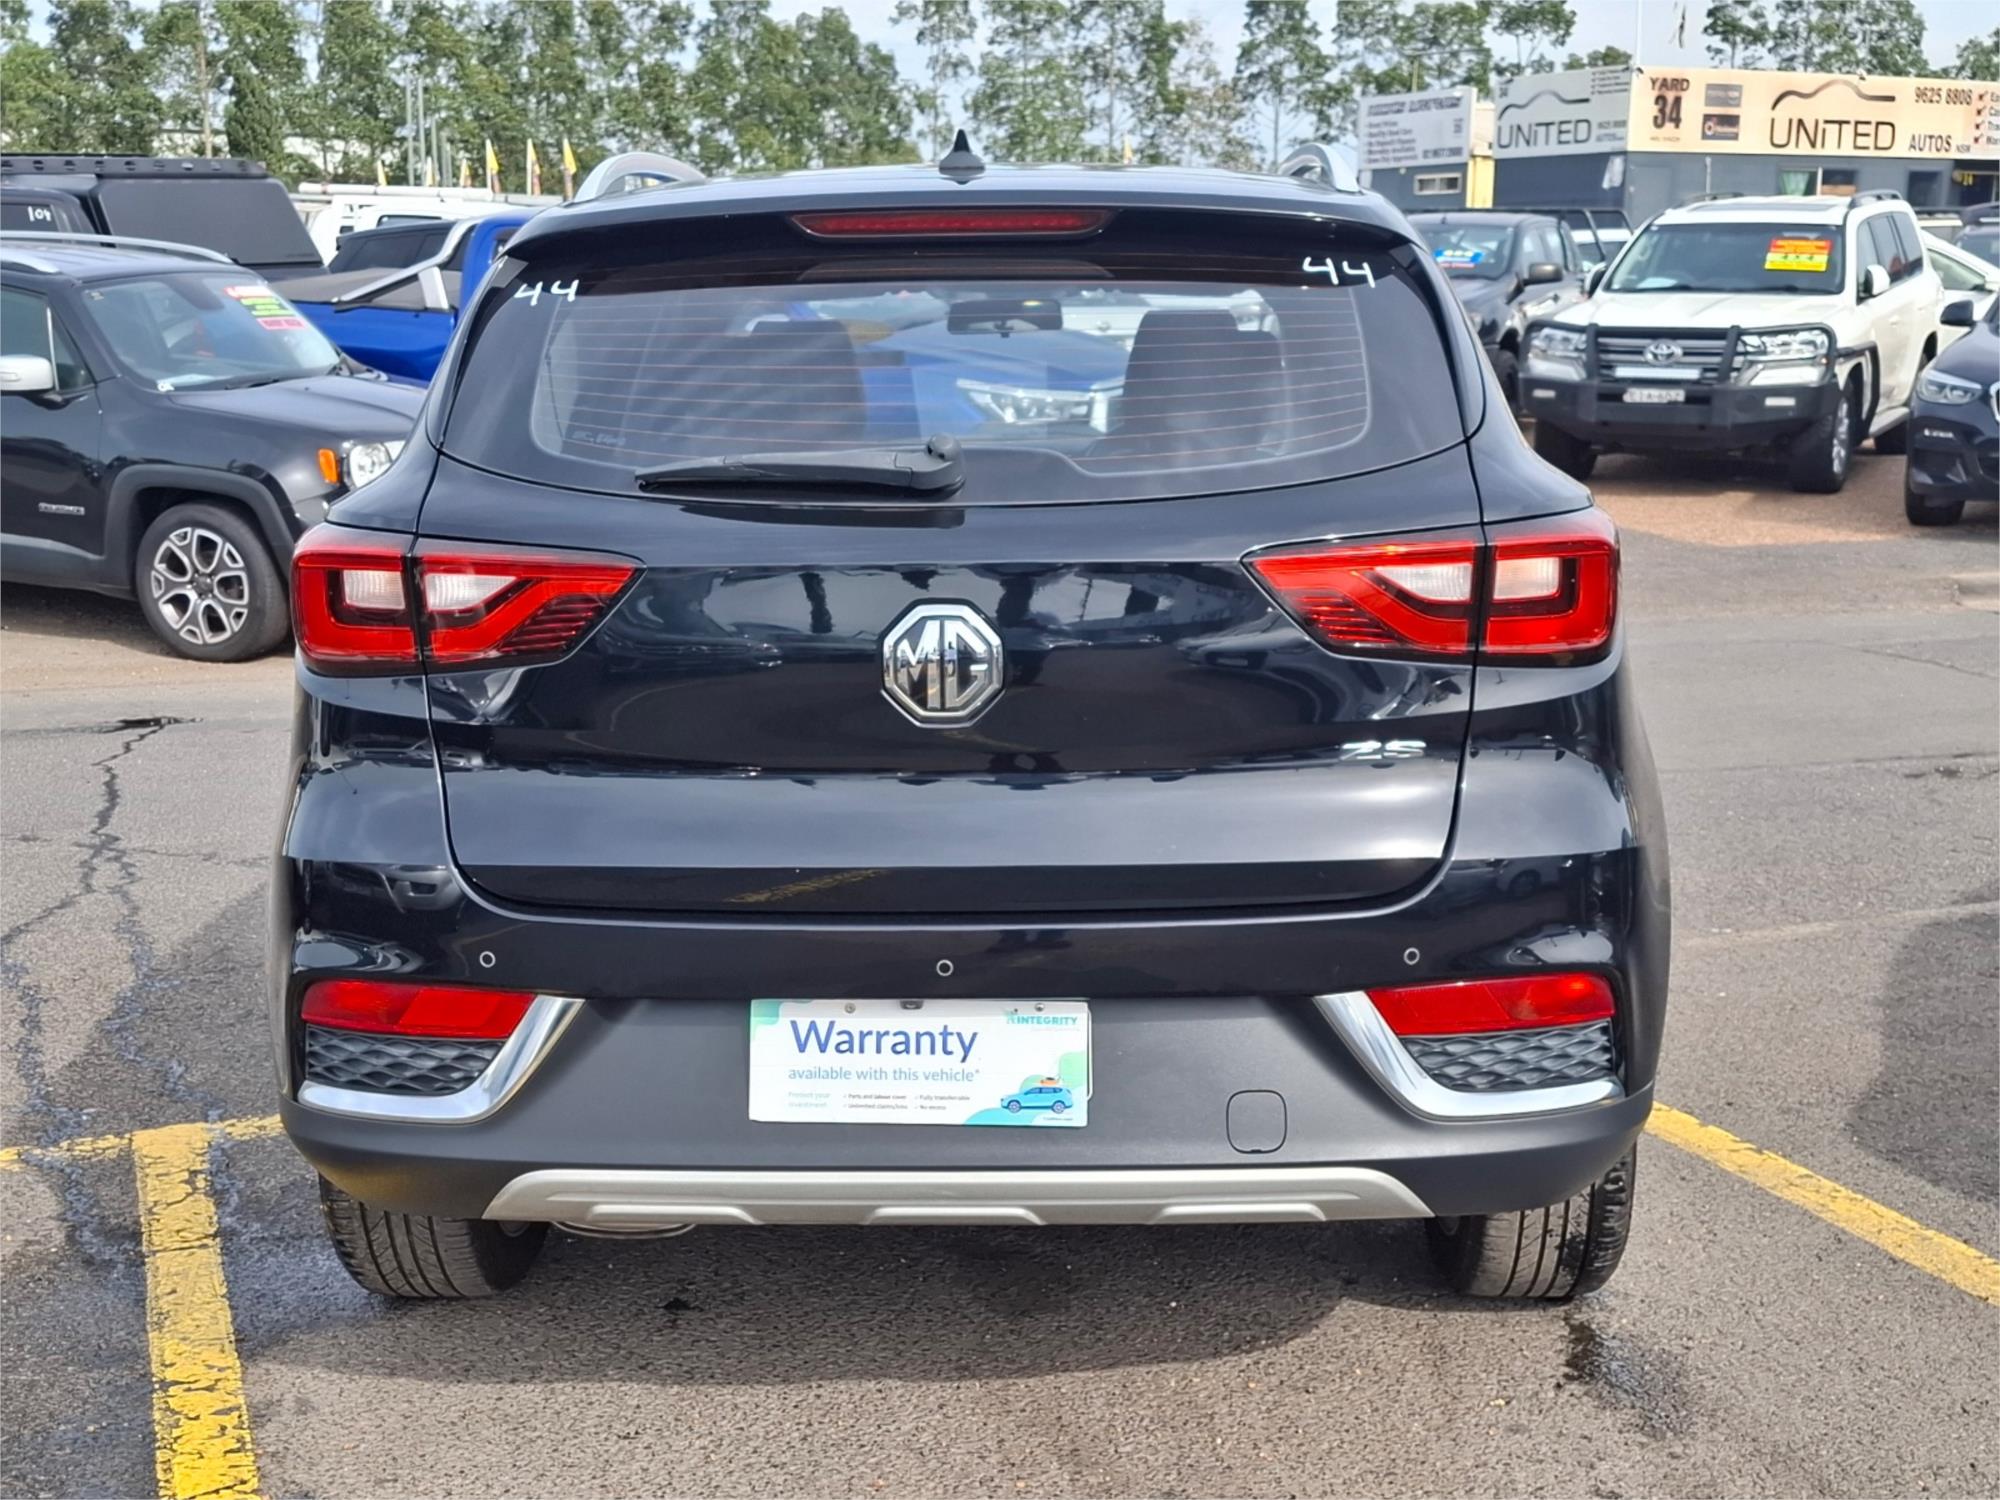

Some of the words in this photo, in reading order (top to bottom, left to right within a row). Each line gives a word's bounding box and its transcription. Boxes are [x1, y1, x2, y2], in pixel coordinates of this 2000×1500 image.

[1650, 77, 1690, 92] YARD
[1914, 86, 1943, 104] 9625
[1653, 94, 1682, 130] 34
[1908, 133, 1953, 153] AUTOS
[1302, 256, 1376, 289] 44
[513, 279, 580, 307] 44
[897, 619, 988, 710] MG
[1341, 740, 1427, 760] ZS
[1016, 1015, 1078, 1026] INTEGRITY
[790, 1019, 979, 1064] Warranty
[788, 1066, 852, 1080] available
[856, 1066, 888, 1081] with
[893, 1066, 919, 1081] this
